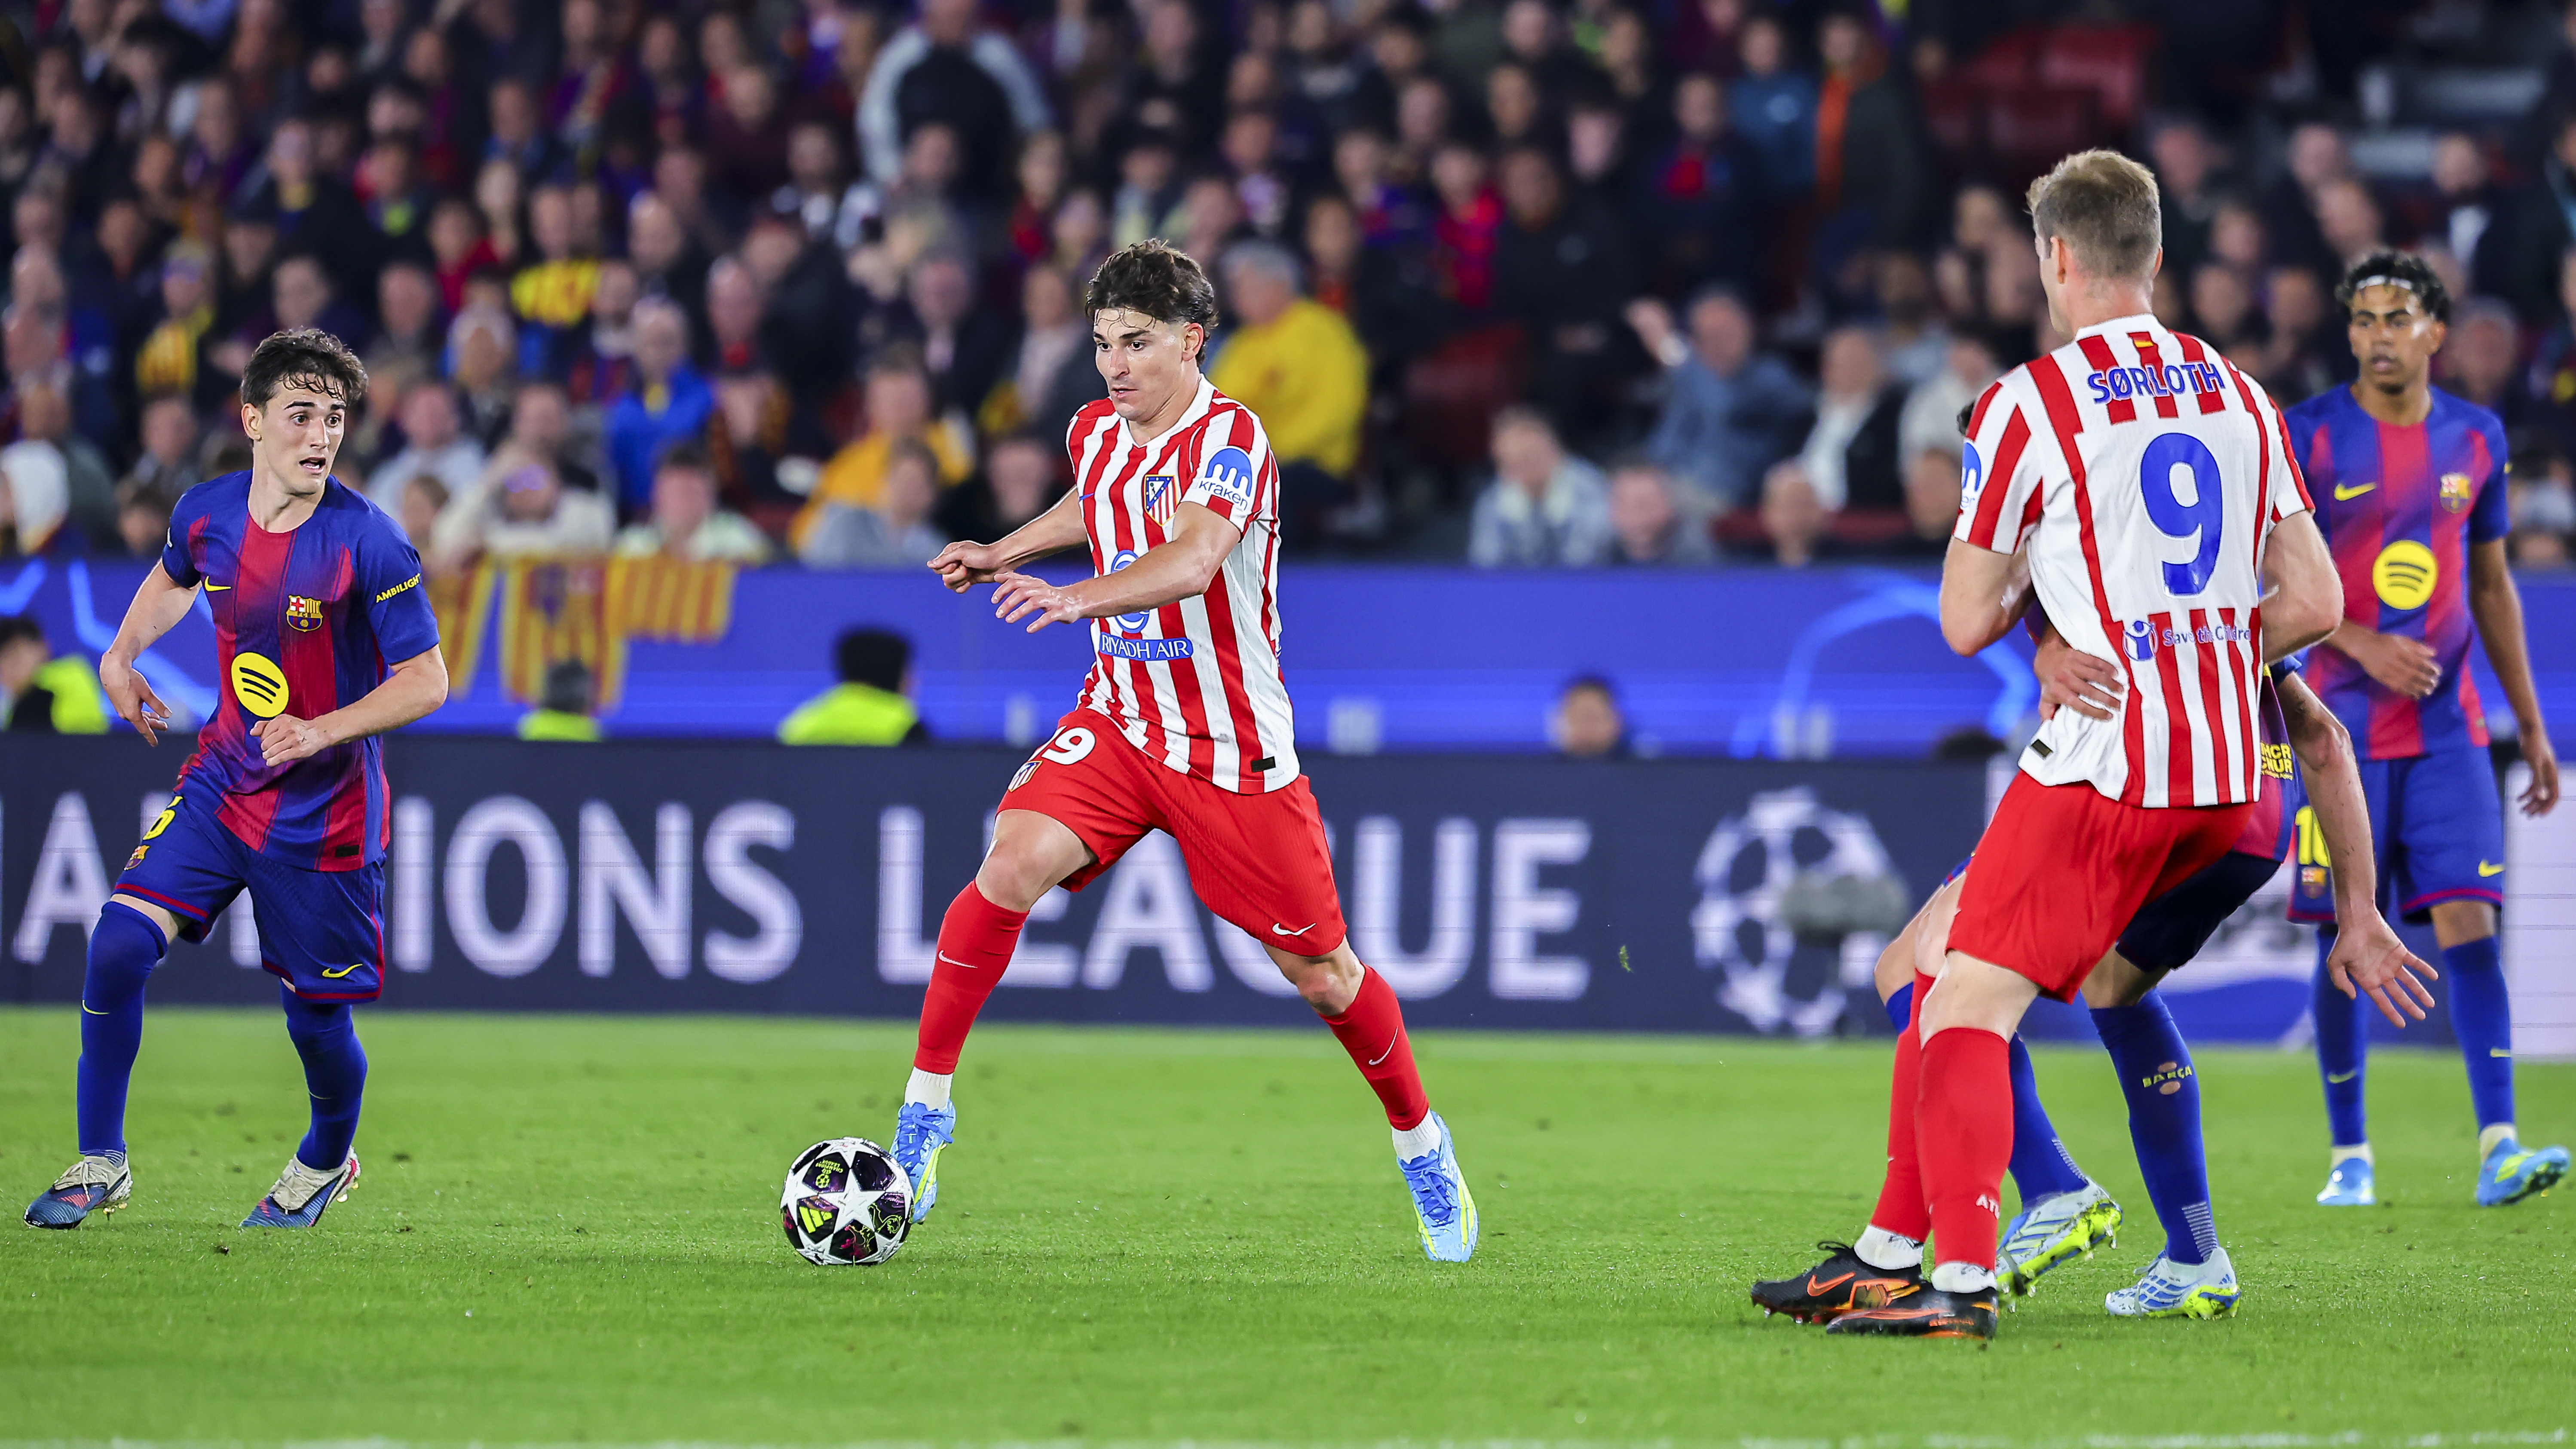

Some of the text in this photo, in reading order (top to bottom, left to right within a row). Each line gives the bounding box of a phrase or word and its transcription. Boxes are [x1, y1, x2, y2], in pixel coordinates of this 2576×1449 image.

[2087, 363, 2226, 404] SØRLOTH
[1199, 480, 1248, 511] kraken
[2140, 432, 2223, 595] 9
[376, 573, 420, 603] AMBILIGH
[1102, 634, 1190, 659] RIYADH AIR
[0, 790, 803, 983] AIONS
